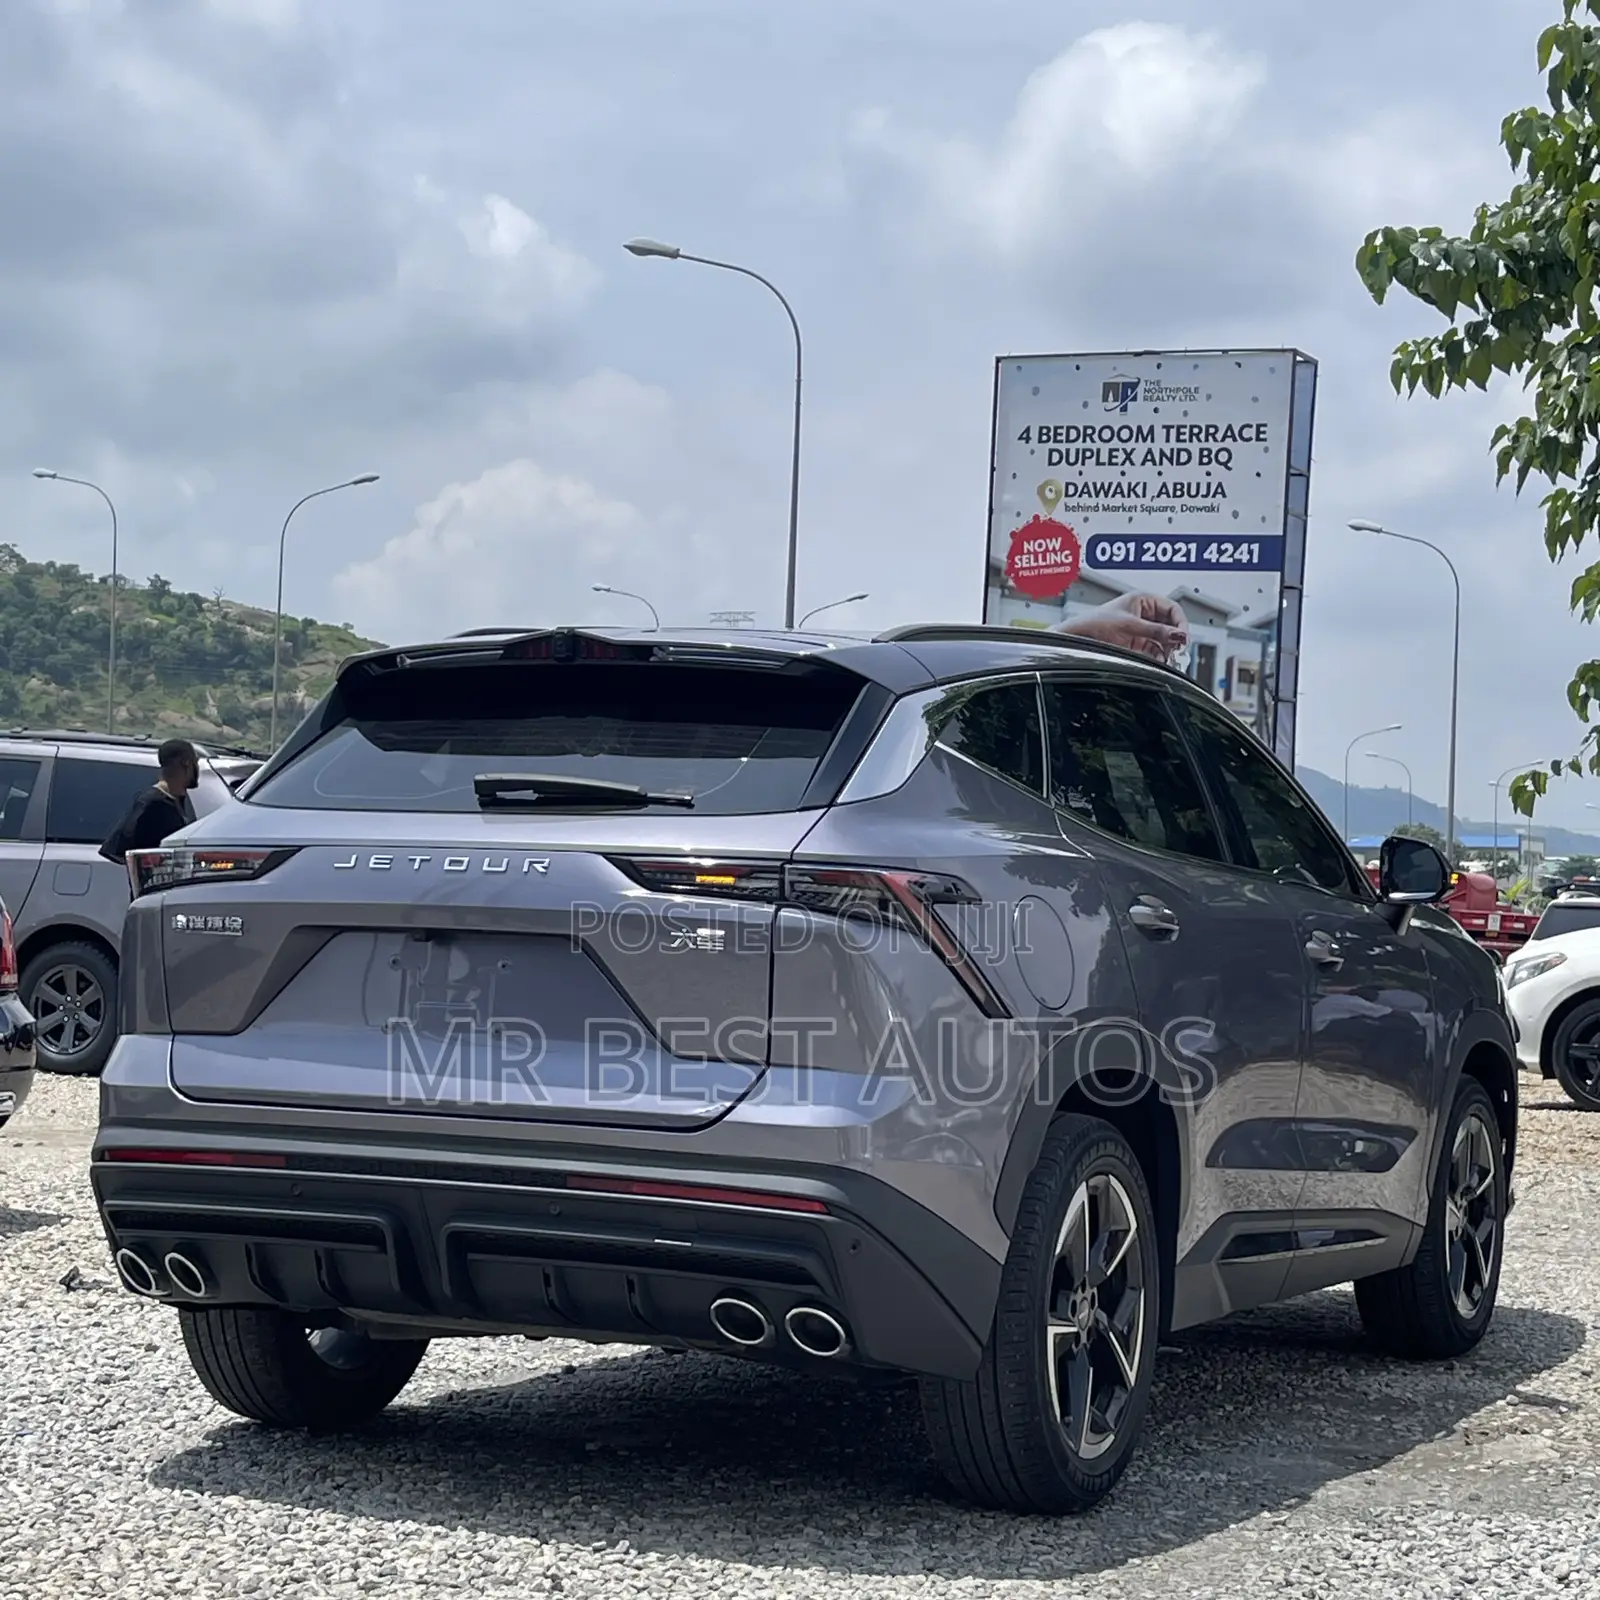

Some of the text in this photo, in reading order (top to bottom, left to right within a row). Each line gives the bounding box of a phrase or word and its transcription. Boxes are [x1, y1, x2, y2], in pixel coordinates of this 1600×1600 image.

[1143, 387, 1200, 395] NORTHPOLE
[1144, 379, 1162, 387] THE
[1143, 394, 1177, 402] REALTY
[1017, 423, 1268, 444] 4 BEDROOM TERRACE
[1047, 447, 1233, 471] DUPLEX AND BQ
[1064, 481, 1147, 499] DAWAKI
[1064, 502, 1100, 513] behind
[1102, 502, 1138, 513] Market
[1139, 502, 1178, 515] Square,
[1023, 537, 1062, 554] NOW
[1094, 540, 1260, 564] 091 2021 4241
[1014, 550, 1073, 568] SELLING
[333, 854, 552, 875] JETOUR
